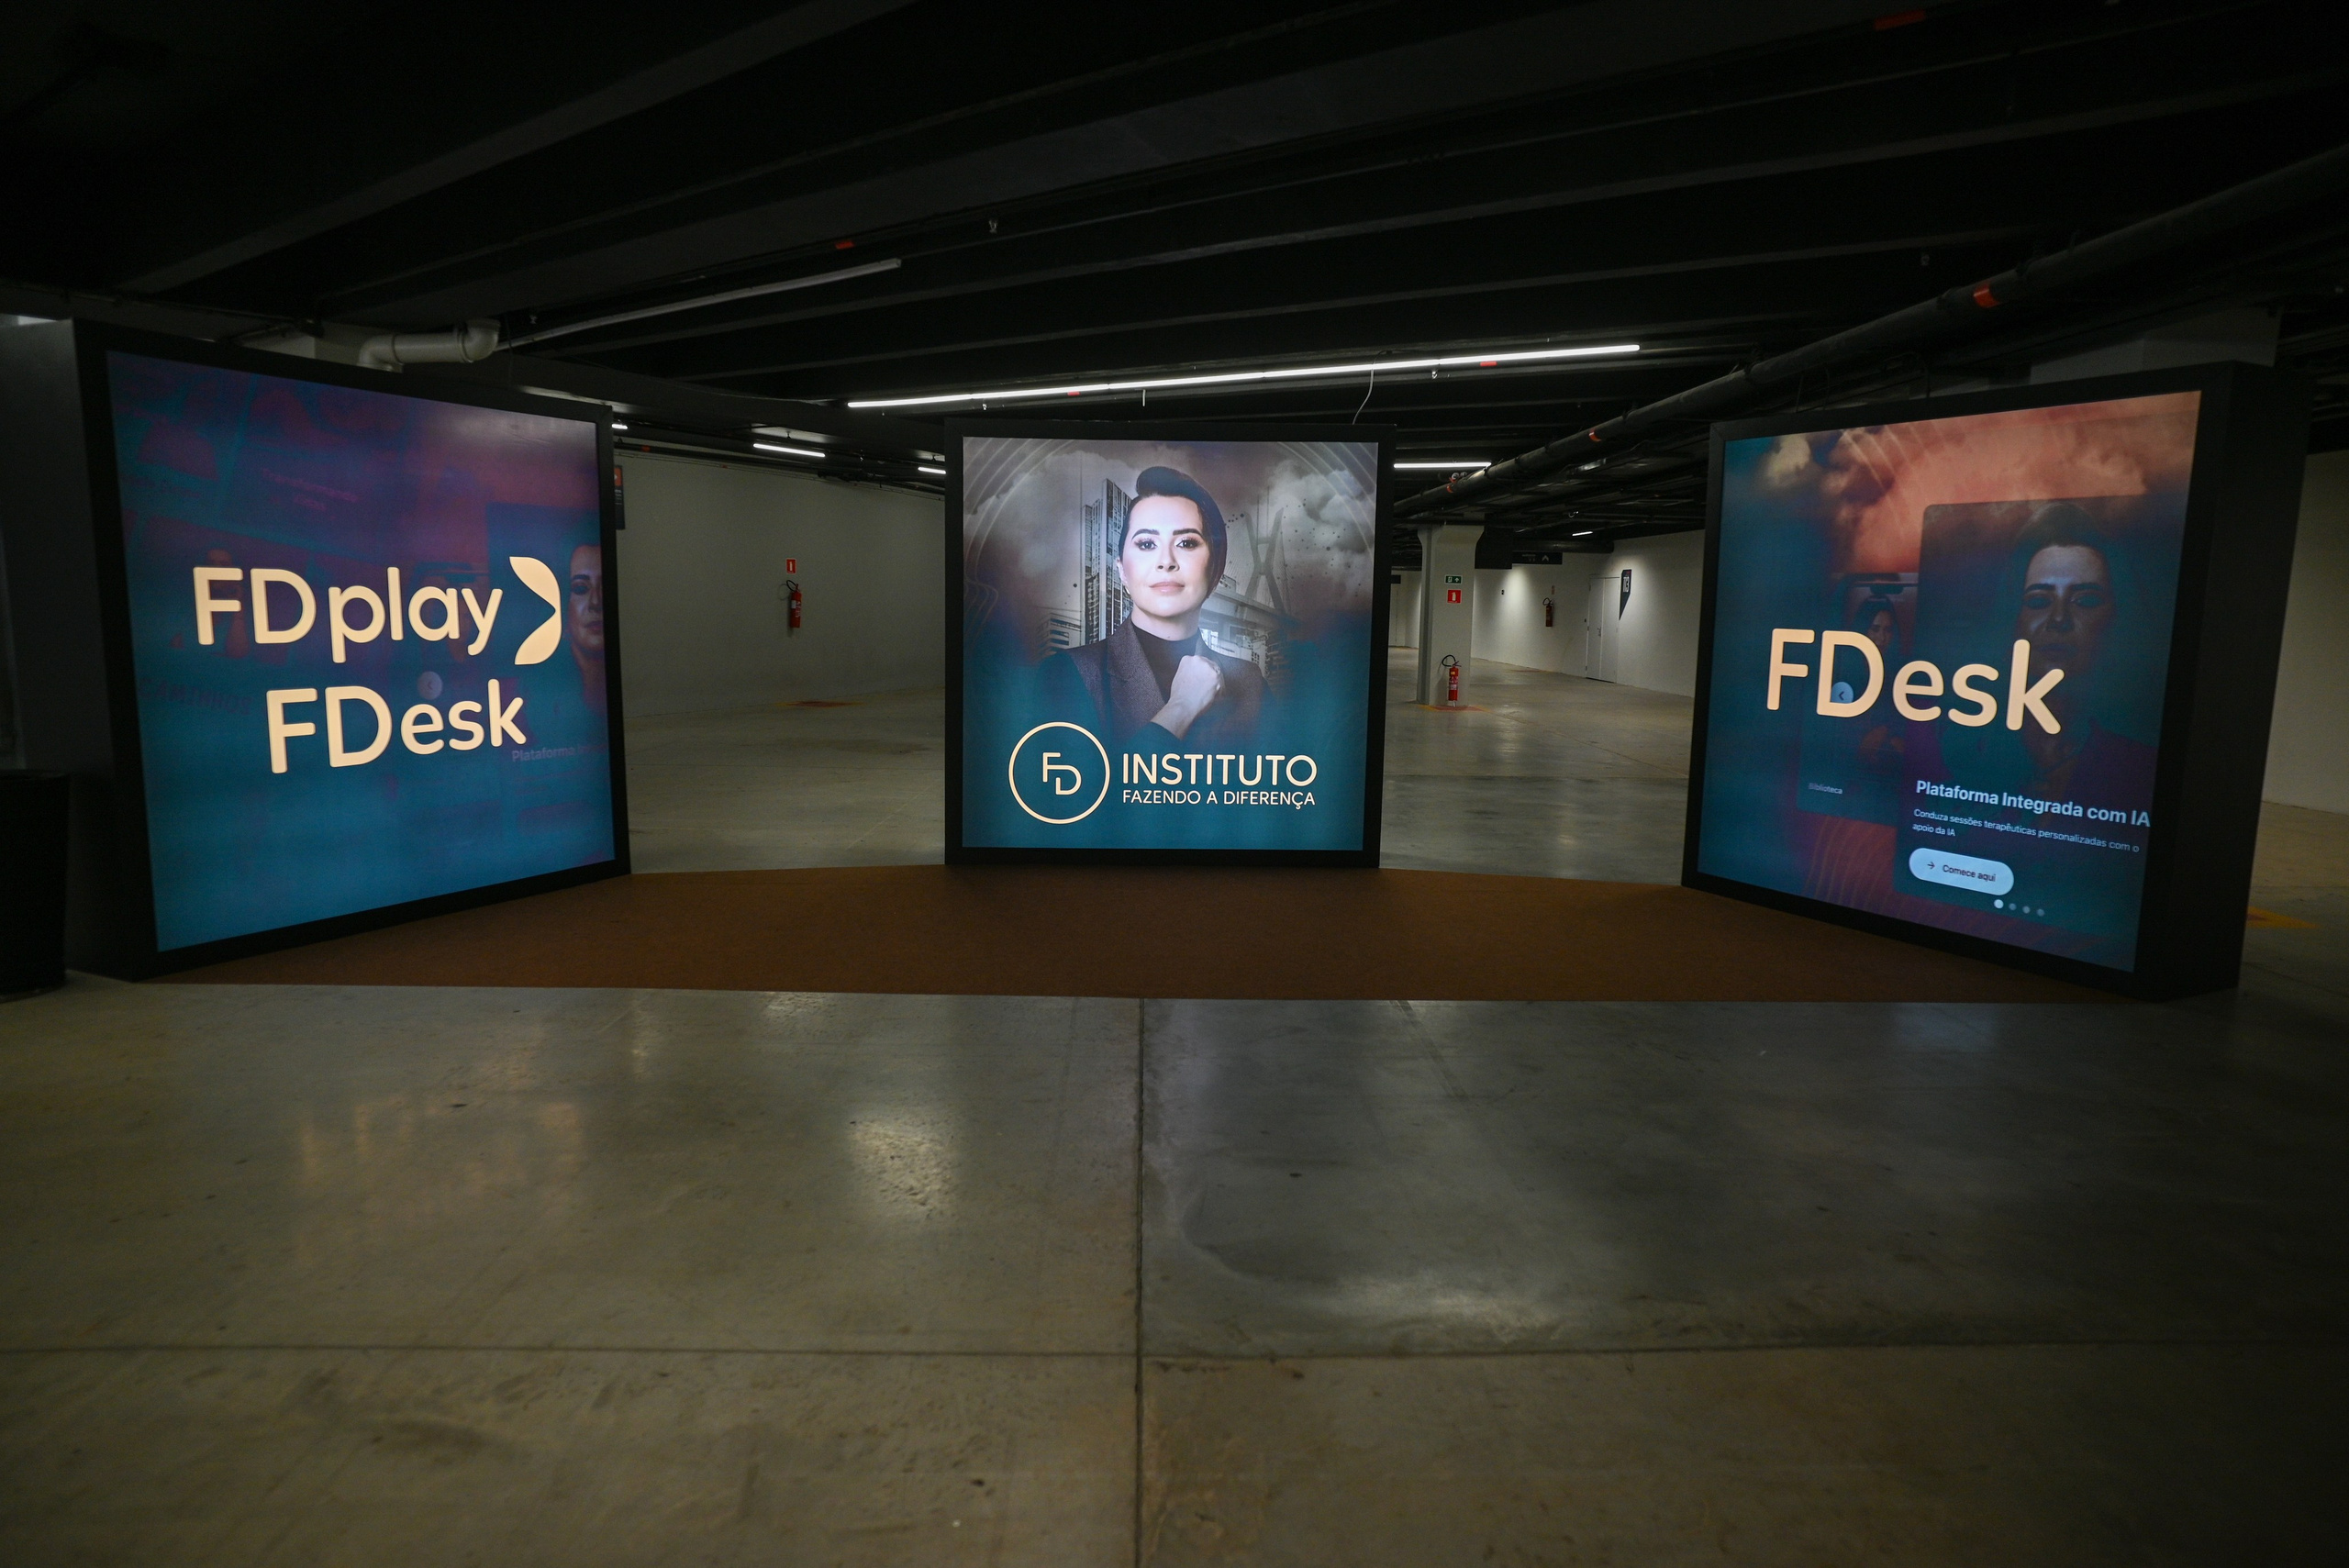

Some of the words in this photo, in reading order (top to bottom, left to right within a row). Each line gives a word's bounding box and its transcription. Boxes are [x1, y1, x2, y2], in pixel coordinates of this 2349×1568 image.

[1766, 628, 2065, 735] FDesk
[266, 678, 527, 773] FDesk
[1122, 752, 1318, 786] INSTITUTO
[1122, 790, 1201, 805] FAZENDO
[1206, 790, 1219, 805] A
[1223, 791, 1316, 810] DIFERENÇA
[1915, 780, 1999, 805] Plataforma
[2001, 792, 2084, 818] Integrada
[2087, 807, 2128, 824] com
[2131, 810, 2151, 828] IA
[1912, 823, 1934, 834] apoio
[1934, 827, 1946, 835] da
[1946, 828, 1956, 837] IA
[1913, 808, 1948, 822] Conduza
[1949, 816, 1983, 828] sessões
[1983, 820, 2037, 837] terapêuticas
[2038, 829, 2107, 848] personalizadas
[2109, 841, 2131, 851] com
[2132, 845, 2140, 853] o
[1942, 864, 1976, 878] Comece
[1977, 872, 1997, 883] aqui
